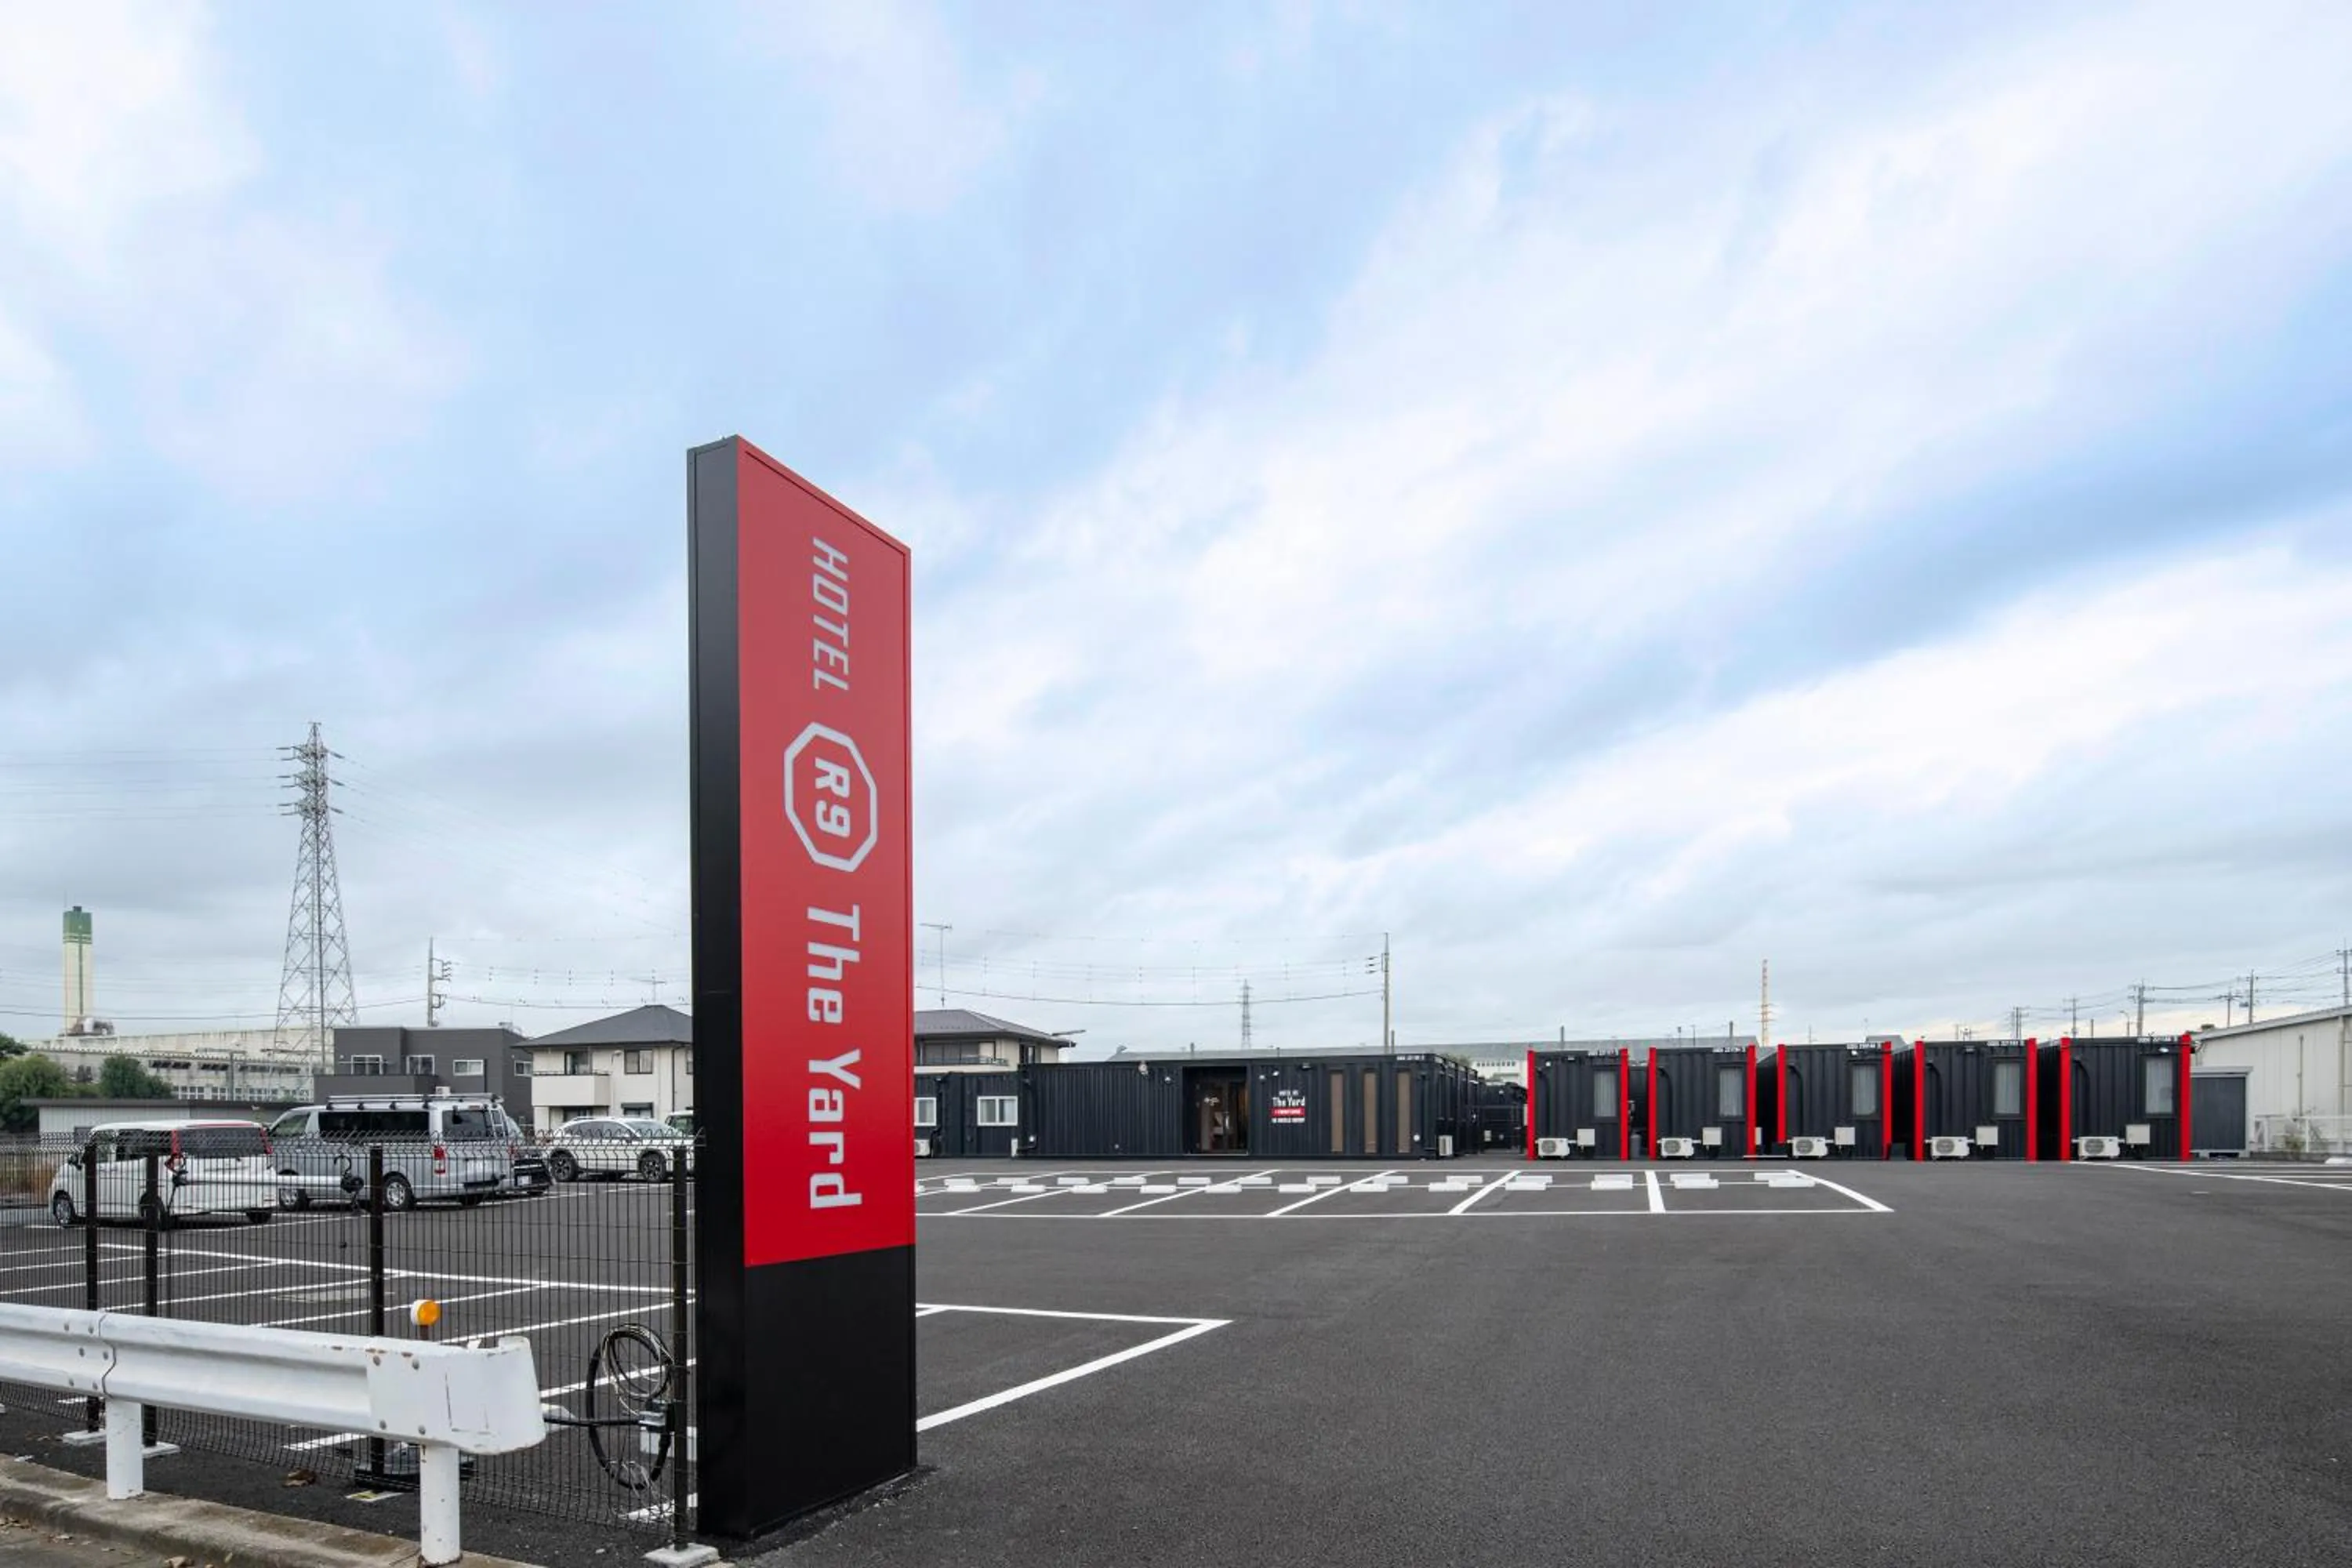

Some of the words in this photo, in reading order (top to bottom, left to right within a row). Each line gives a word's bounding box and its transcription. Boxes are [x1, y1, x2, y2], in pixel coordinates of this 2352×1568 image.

[812, 536, 850, 691] HOTEL
[814, 757, 851, 838] R9
[807, 904, 861, 1025] The
[808, 1048, 862, 1210] Yard
[1272, 1097, 1287, 1107] The
